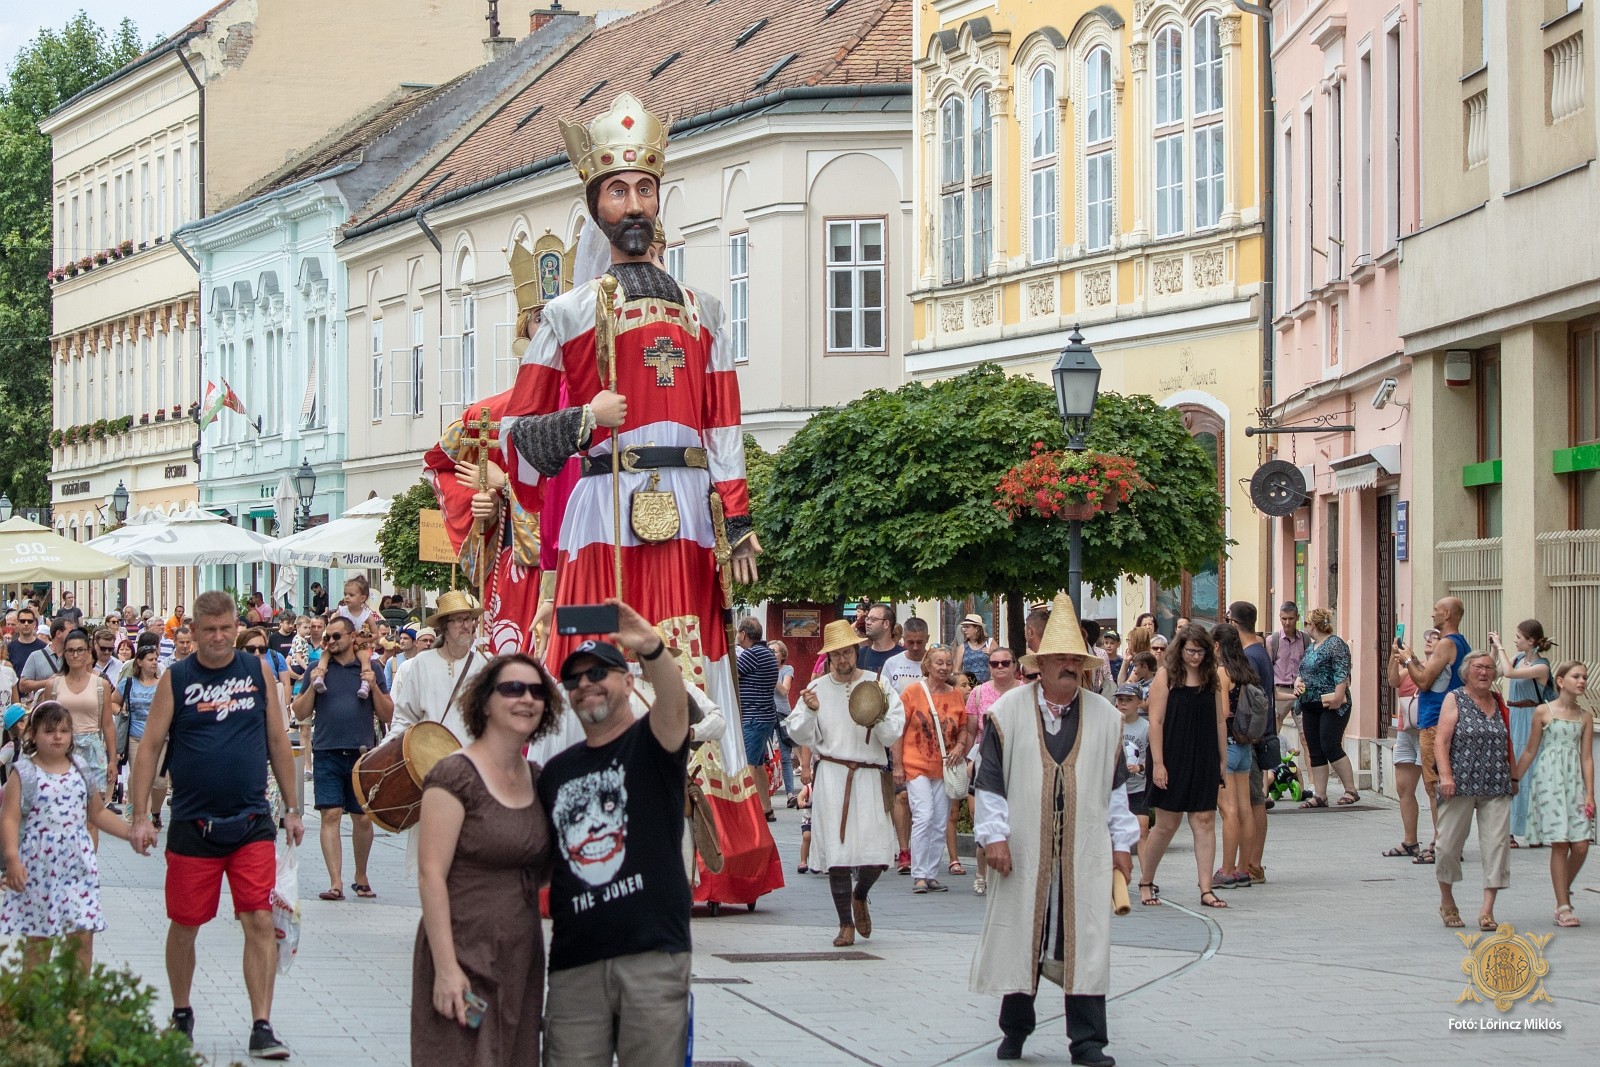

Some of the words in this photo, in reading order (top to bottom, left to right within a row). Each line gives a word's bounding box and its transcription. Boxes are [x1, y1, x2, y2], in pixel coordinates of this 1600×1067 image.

[9, 555, 39, 564] LAGER
[184, 675, 253, 706] Digital
[571, 891, 596, 914] THE
[602, 873, 644, 902] JOKER
